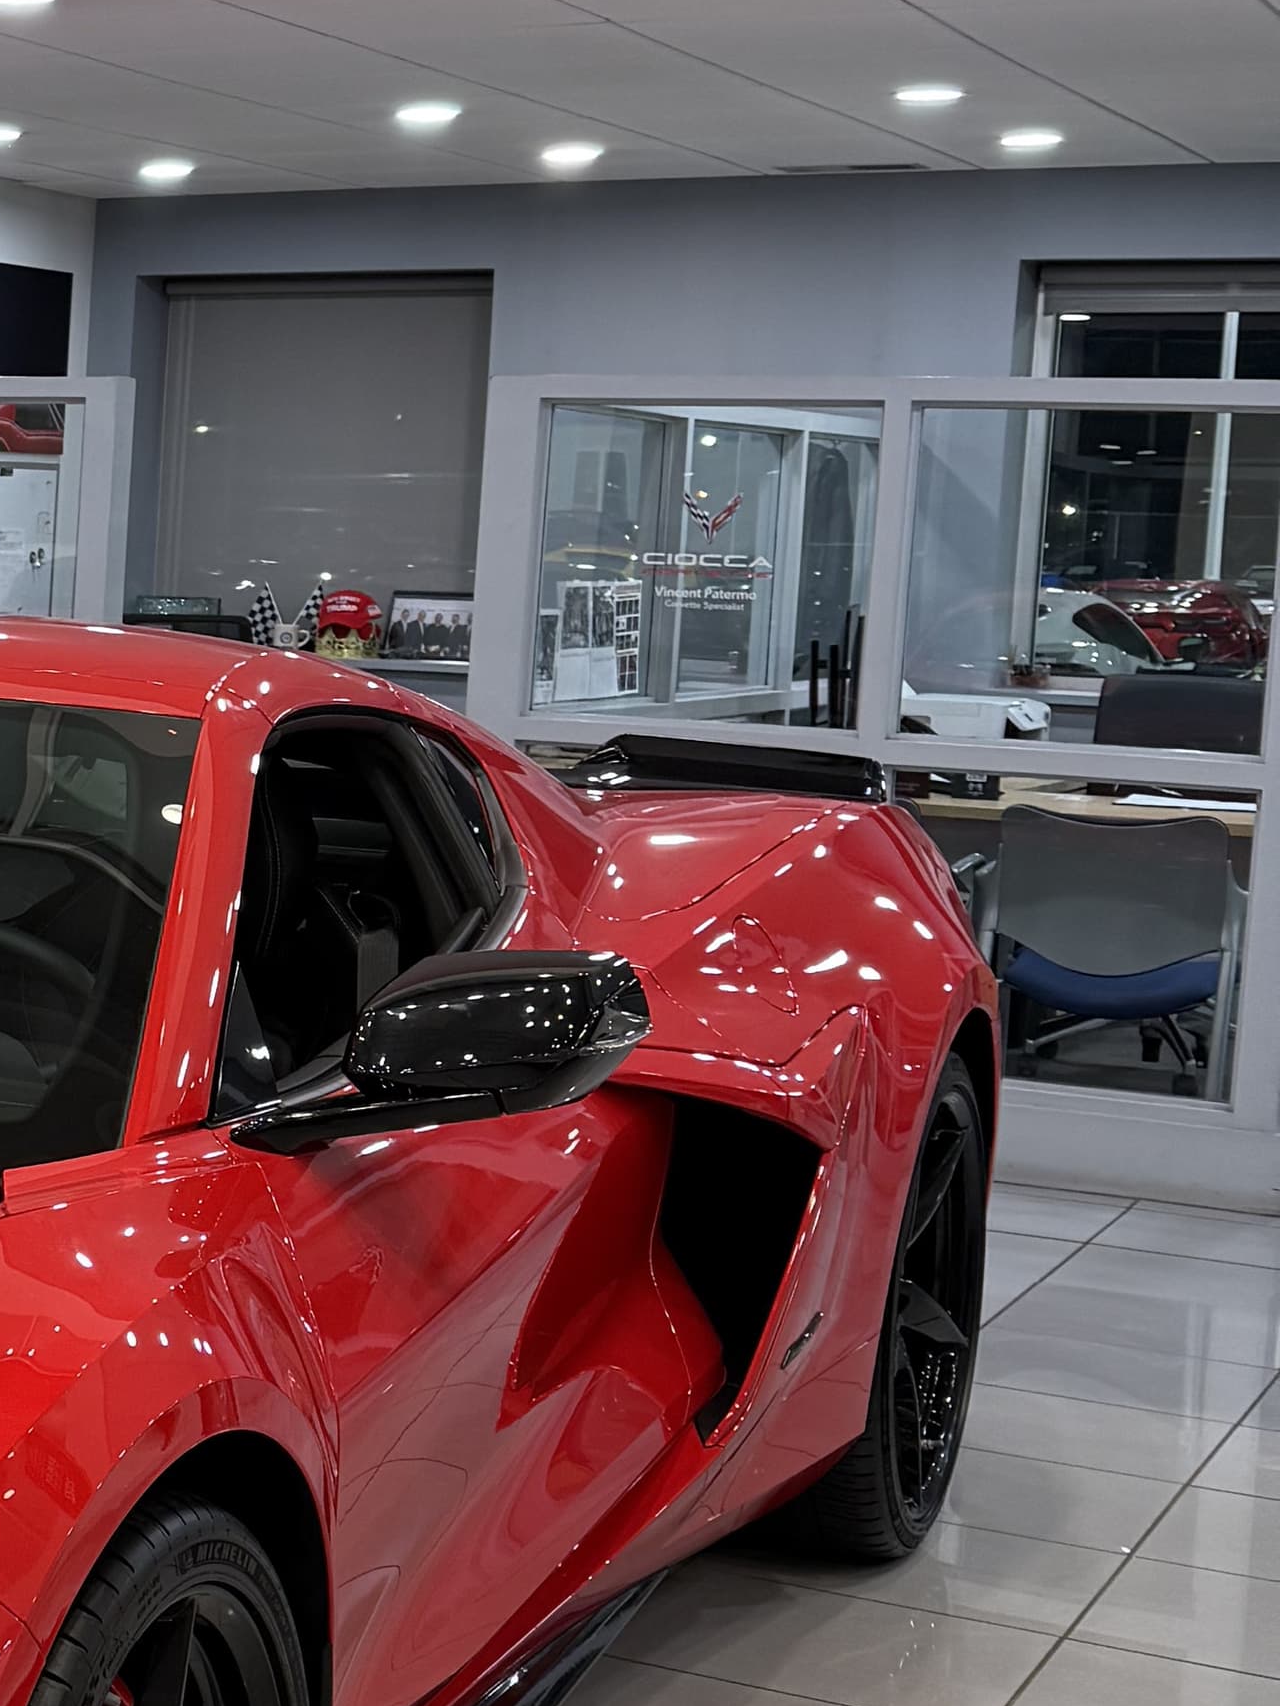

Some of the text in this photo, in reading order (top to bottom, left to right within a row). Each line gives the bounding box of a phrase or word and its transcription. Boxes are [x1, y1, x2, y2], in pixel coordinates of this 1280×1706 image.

[642, 552, 773, 569] CIOCCA
[654, 586, 701, 598] Vincent
[196, 1542, 259, 1576] MICHELIN
